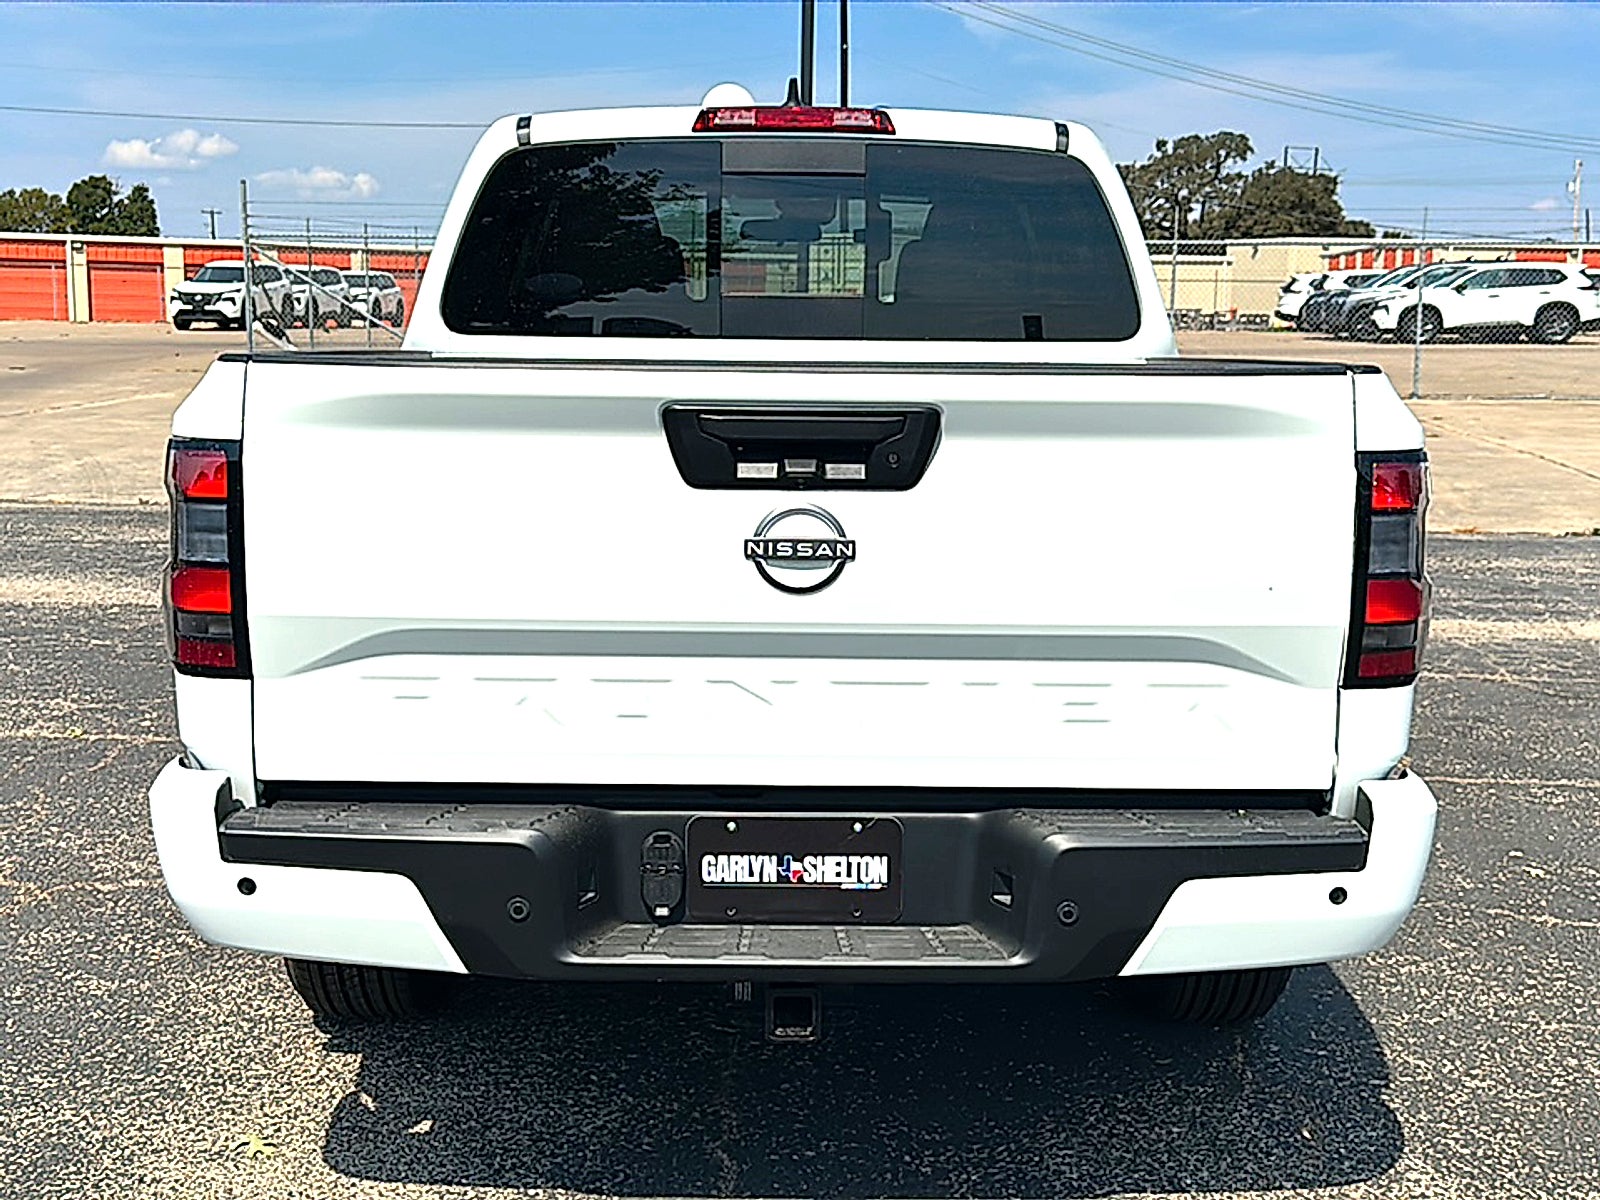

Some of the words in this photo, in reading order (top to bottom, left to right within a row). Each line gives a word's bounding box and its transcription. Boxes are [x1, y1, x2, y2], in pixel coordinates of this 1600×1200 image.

[746, 541, 854, 557] NISSAN
[701, 854, 778, 883] GARLYN
[802, 855, 888, 884] SHELTON
